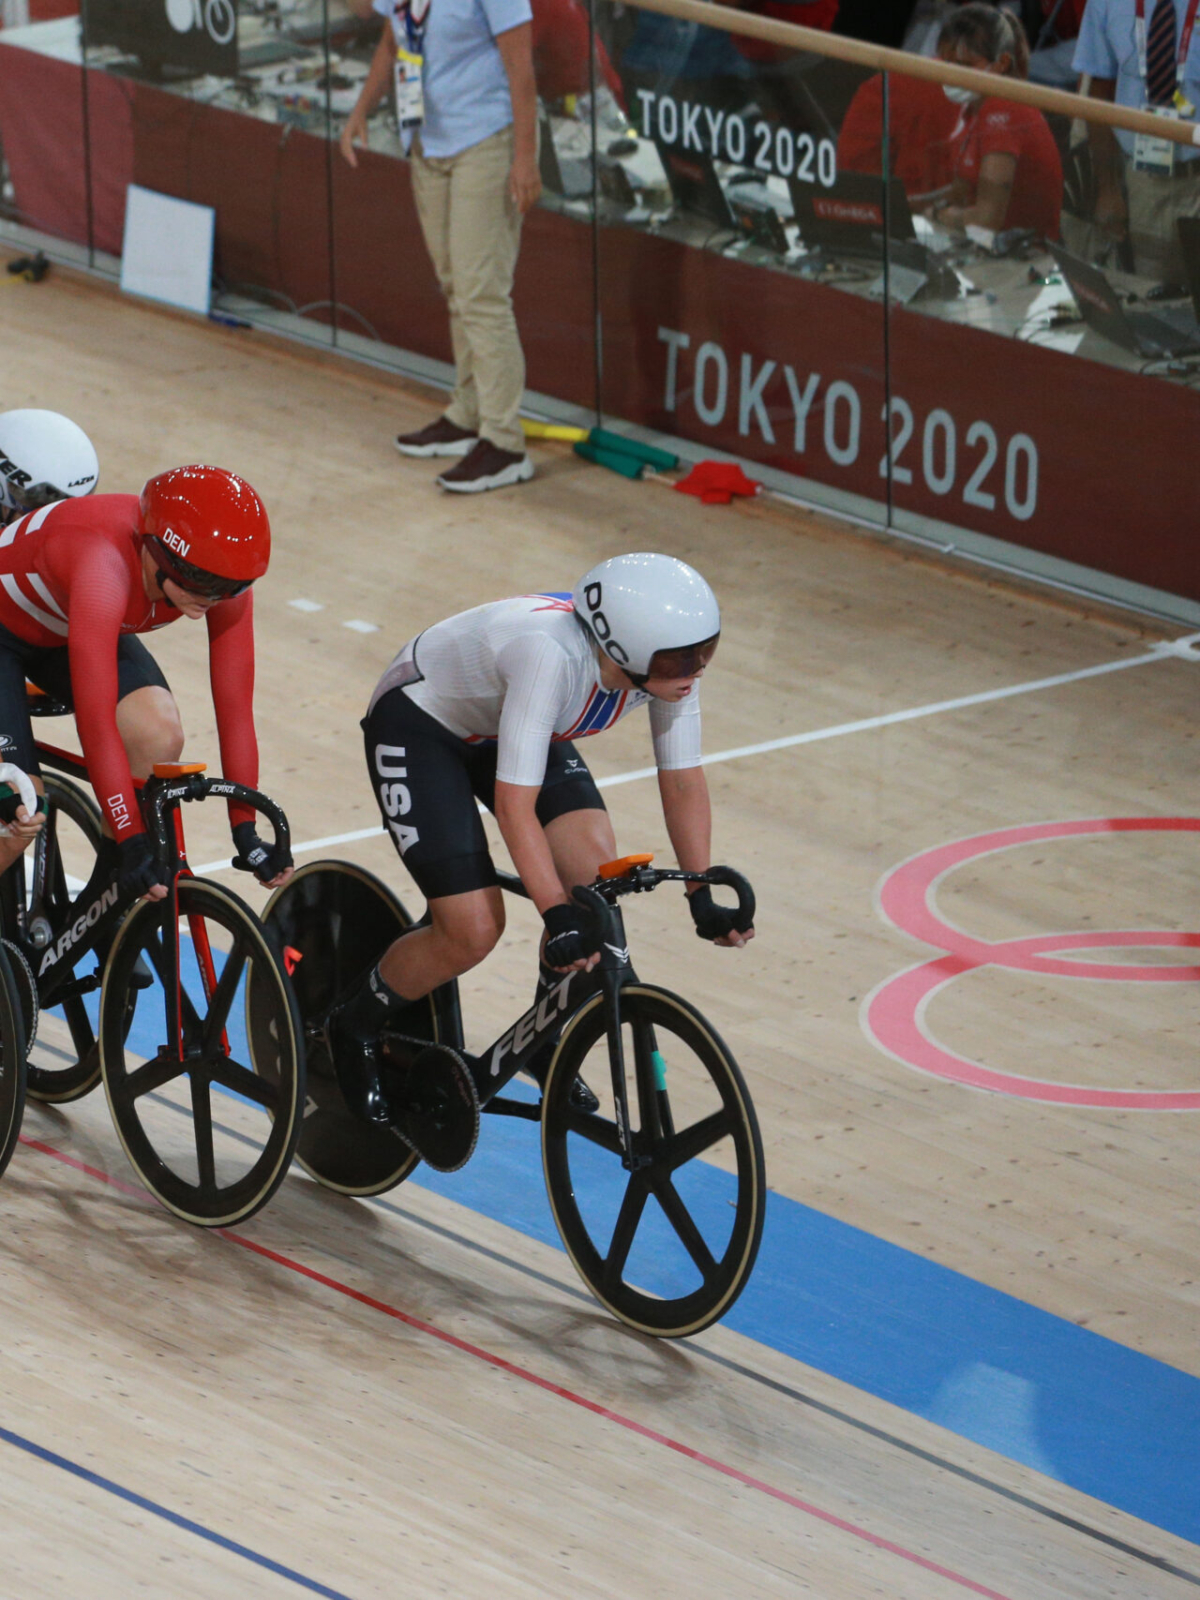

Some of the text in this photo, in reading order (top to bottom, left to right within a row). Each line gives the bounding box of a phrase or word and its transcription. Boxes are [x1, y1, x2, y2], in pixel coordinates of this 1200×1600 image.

[636, 88, 837, 188] TOKYO 2020
[657, 326, 1039, 521] TOKYO 2020
[162, 527, 191, 557] DEN
[107, 793, 132, 830] DEN
[375, 743, 420, 857] USA
[37, 882, 120, 978] ARGON
[490, 970, 577, 1077] FELT
